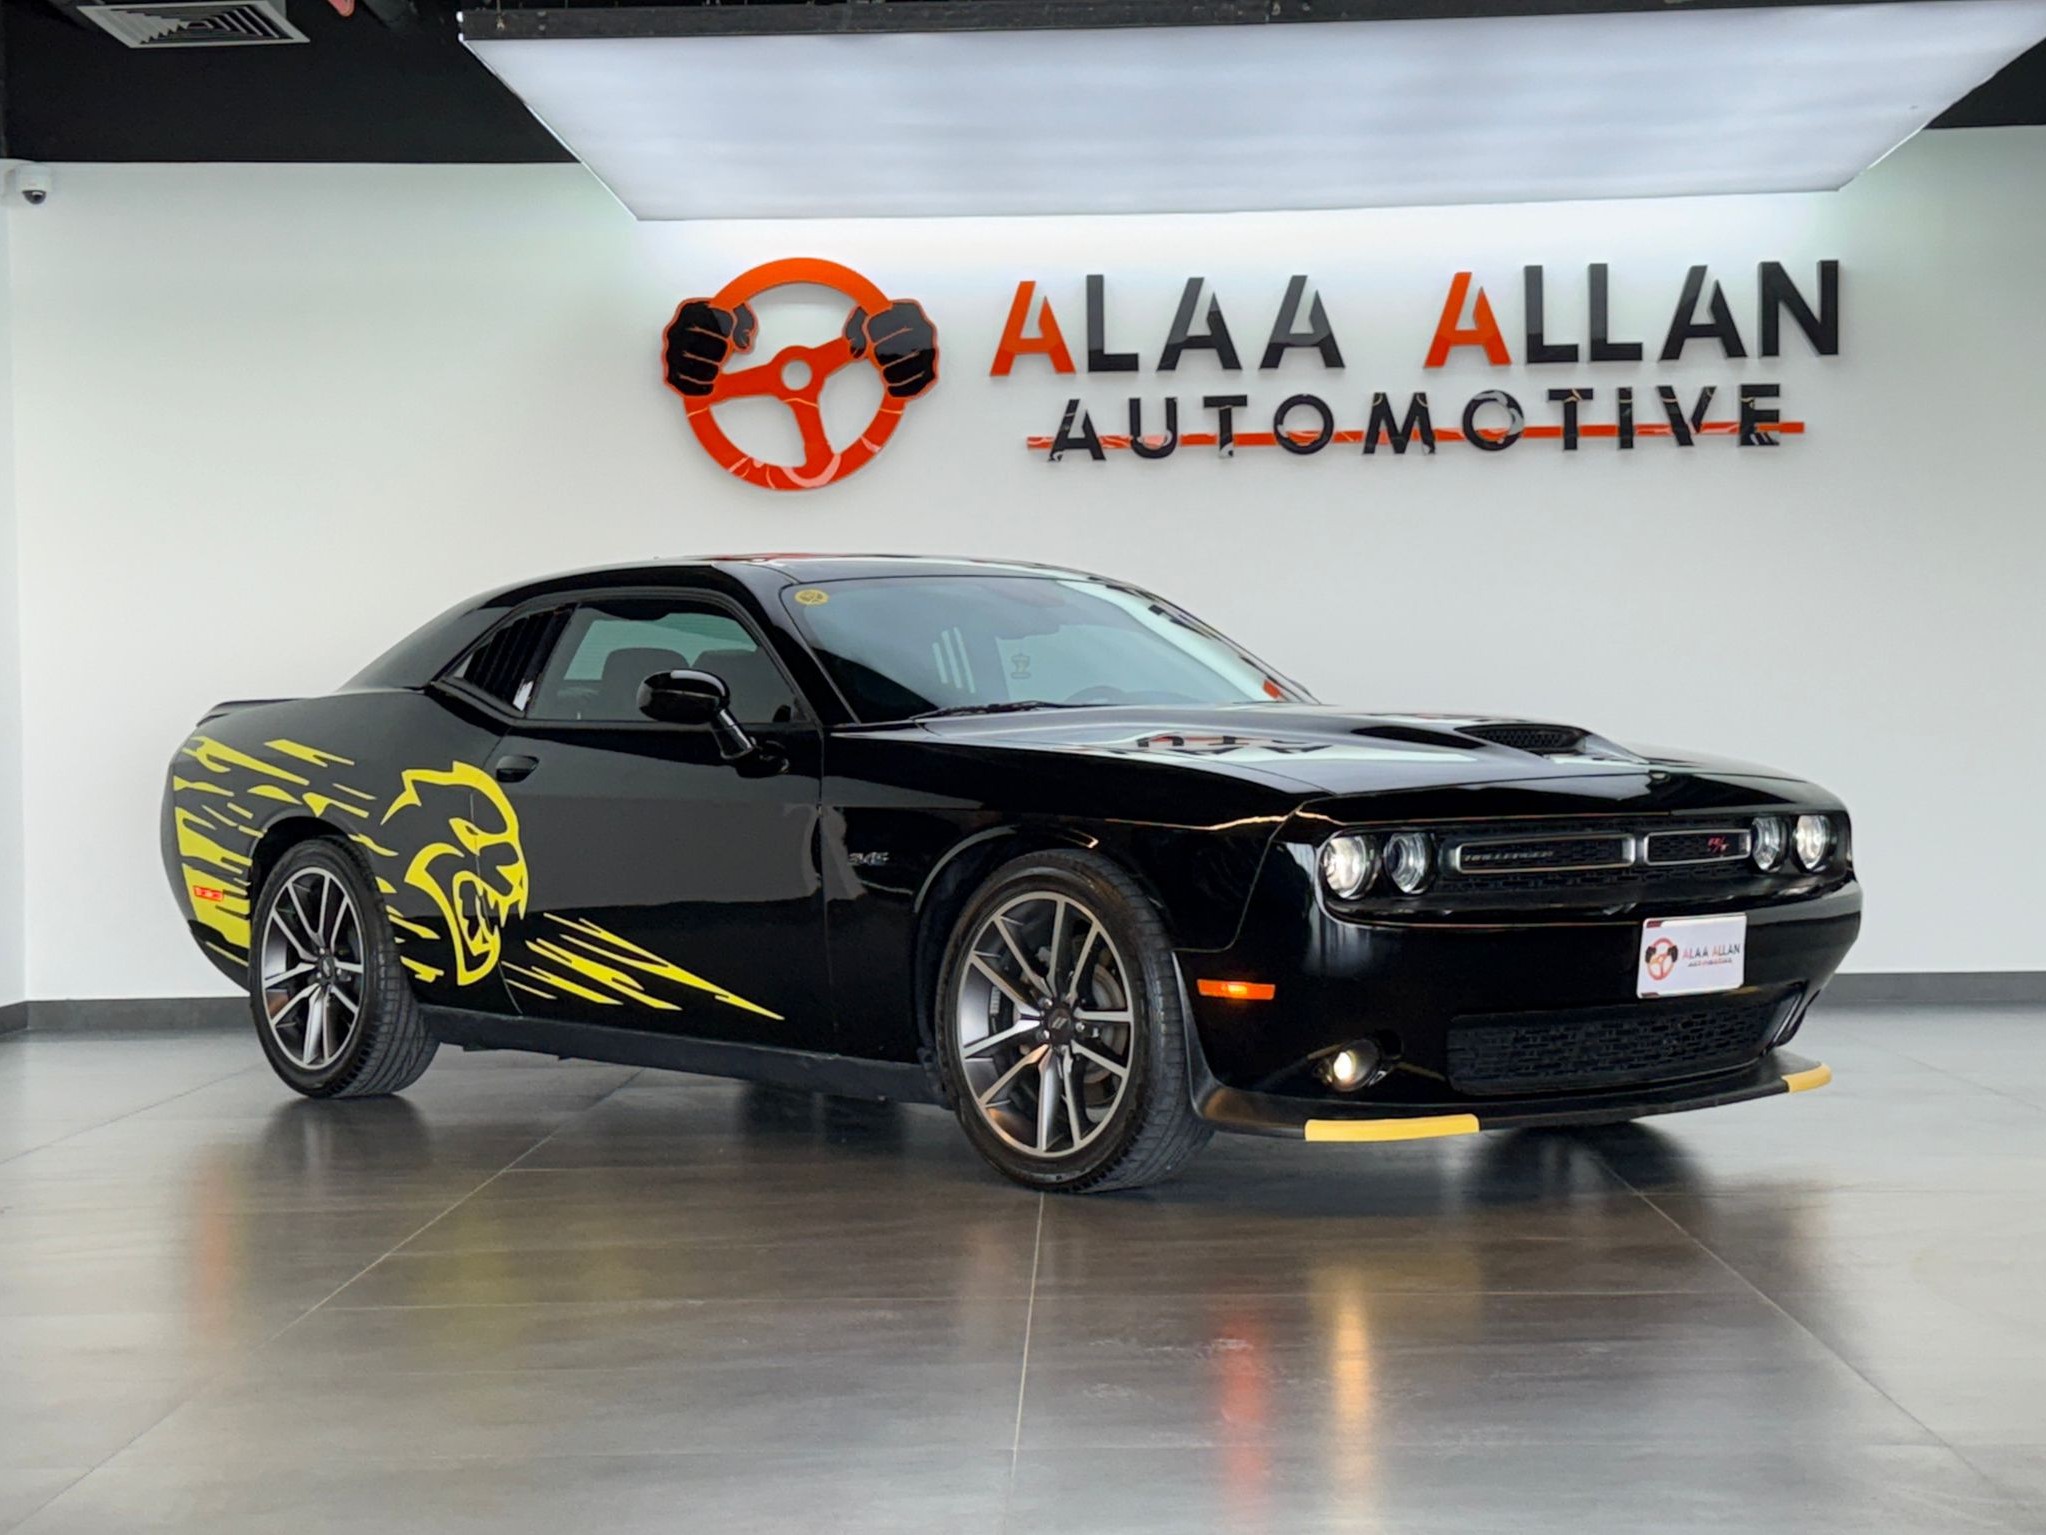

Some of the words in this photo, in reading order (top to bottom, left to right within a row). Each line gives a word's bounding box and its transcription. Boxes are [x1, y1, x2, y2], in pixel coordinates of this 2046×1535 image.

[989, 274, 1346, 377] ALAA
[1424, 259, 1840, 367] ALLAN
[1048, 383, 1782, 462] AUTOMOTIVE
